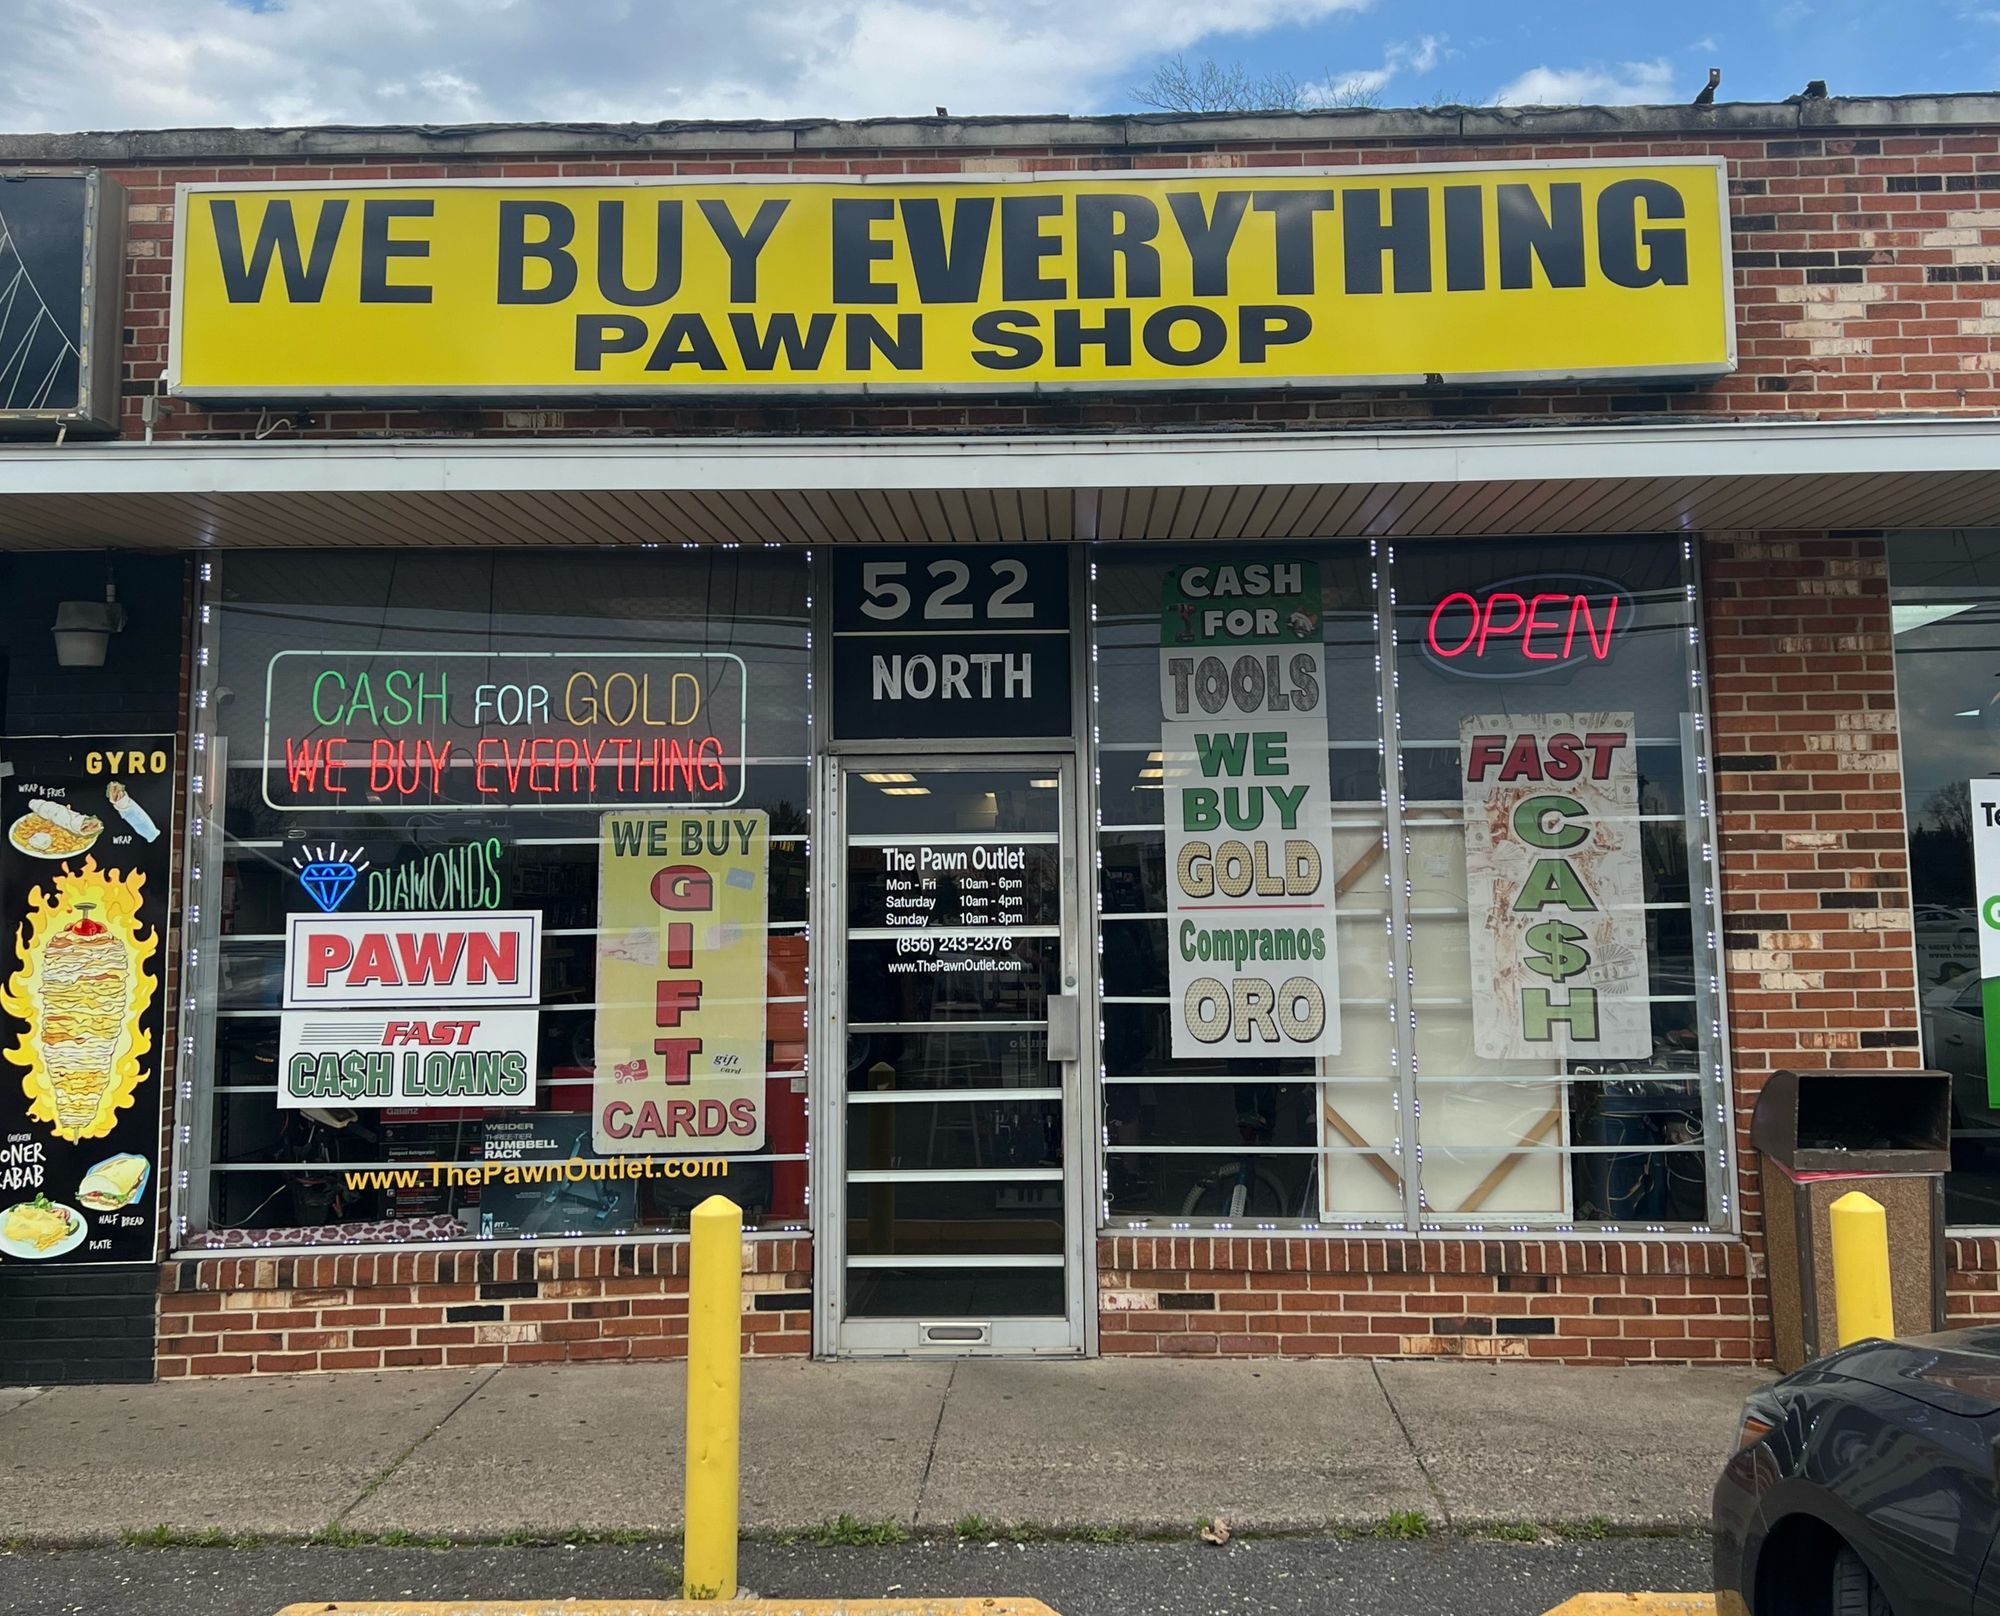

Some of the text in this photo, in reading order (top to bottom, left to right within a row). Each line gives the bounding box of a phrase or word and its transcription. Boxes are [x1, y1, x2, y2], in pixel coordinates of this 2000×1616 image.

[209, 178, 1690, 306] WE BUY EVERYTHING
[574, 304, 1313, 371] PAWN SHOP
[859, 559, 1034, 620] 522
[1180, 563, 1301, 597] CASH
[1203, 608, 1279, 637] FOR
[1427, 592, 1619, 660] OPEN
[872, 653, 1032, 700] NORTH
[1168, 653, 1319, 714] TOOLS
[311, 670, 701, 726] CASH FOR GOLD
[85, 750, 167, 774] GYRO
[286, 735, 726, 794] WE BUY EVERYTHING
[1193, 731, 1289, 777] WE
[1467, 732, 1628, 782] FAST
[18, 783, 38, 793] WRAP
[47, 787, 66, 799] FRIES
[1181, 785, 1311, 831] BUY
[113, 835, 132, 845] WRAP
[612, 820, 757, 857] WE BUY
[368, 837, 501, 911] DIAMONDS
[882, 846, 1025, 871] The Pawn Outlet
[1177, 840, 1322, 898] GOLD
[886, 879, 911, 890] Mon
[922, 878, 936, 890] Fri
[959, 878, 988, 889] 10am
[999, 877, 1022, 891] 6pm
[886, 896, 936, 910] Saturday
[959, 895, 988, 906] 10am
[998, 895, 1022, 909] 4pm
[886, 914, 928, 927] Sunday
[959, 913, 988, 924] 10am
[999, 912, 1023, 926] 3pm
[306, 932, 519, 987] PAWN
[896, 936, 1012, 956] (856) 243-2376
[1179, 919, 1326, 971] Compramos
[888, 959, 1021, 973] www.ThePawnOutlet.com
[1184, 976, 1326, 1043] ORO
[381, 1021, 480, 1046] FAST
[288, 1050, 527, 1099] CA$H LOANS
[713, 1054, 739, 1066] gift
[720, 1066, 742, 1075] card
[485, 1123, 534, 1131] WEIDER
[603, 1098, 757, 1139] CARDS
[484, 1139, 558, 1150] DUMBBELL
[485, 1133, 532, 1141] THREE-TIER
[0, 1142, 47, 1166] ONER
[484, 1149, 522, 1159] RACK
[0, 1164, 44, 1190] ABAB
[345, 1155, 729, 1191] www.ThePawnOutlet.com
[98, 1213, 144, 1228] HALF BREAD
[89, 1240, 112, 1250] PLATE
